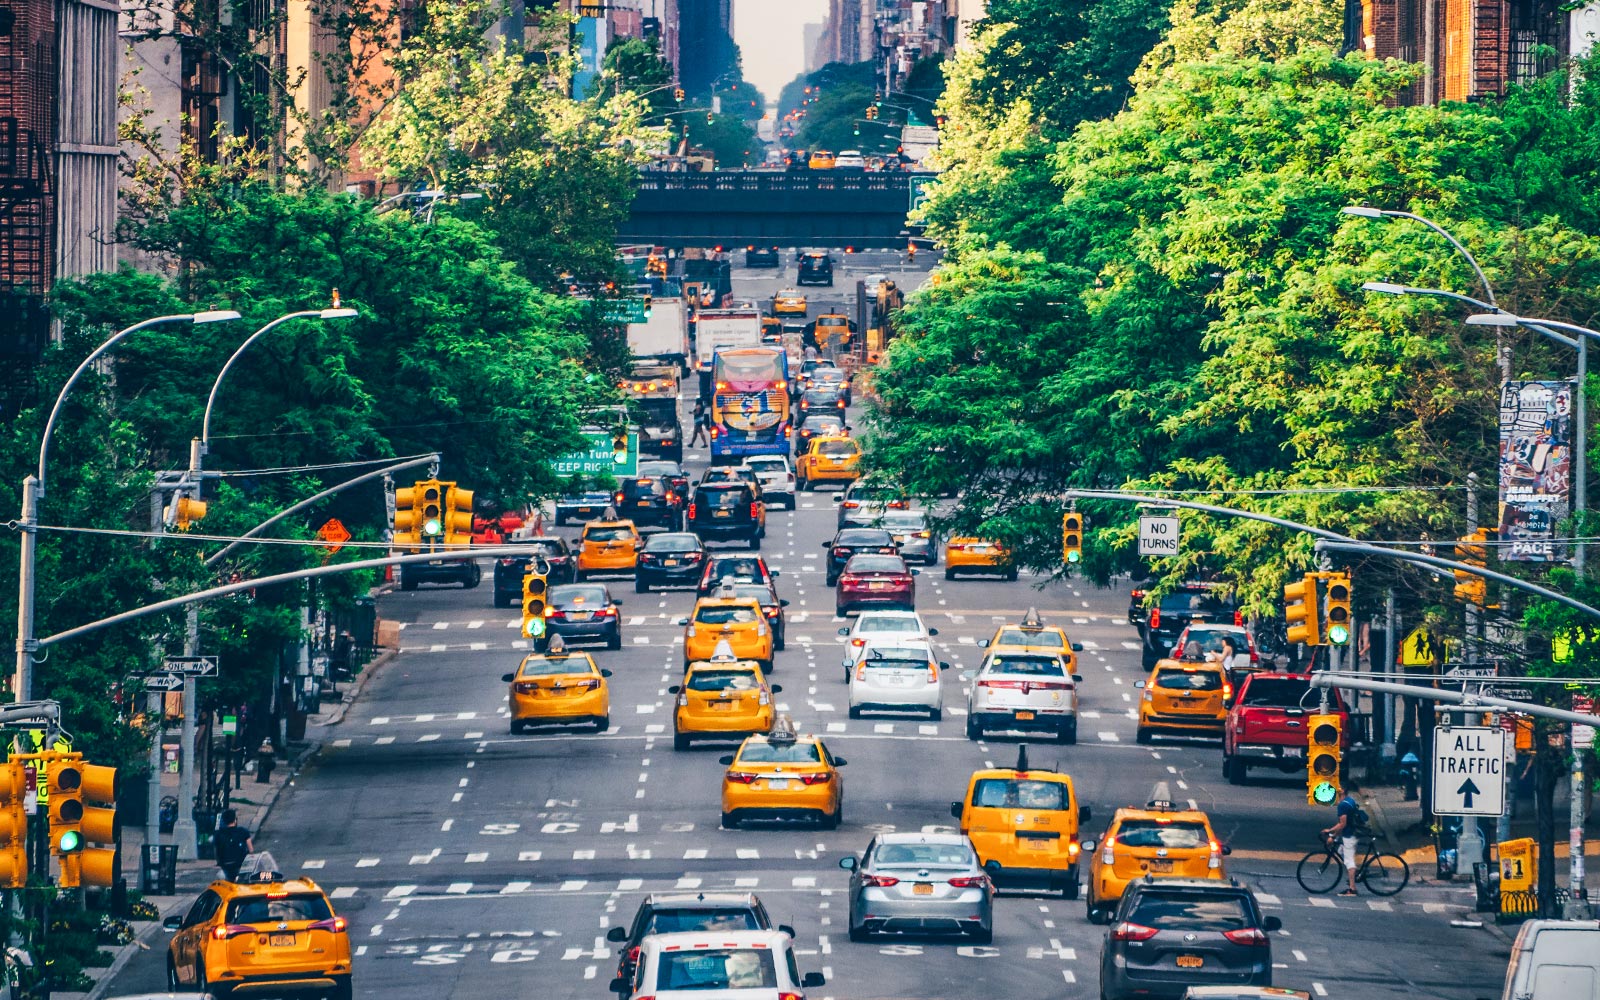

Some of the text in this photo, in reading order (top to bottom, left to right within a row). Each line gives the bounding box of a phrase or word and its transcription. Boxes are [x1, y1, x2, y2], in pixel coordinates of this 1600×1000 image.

[1506, 486, 1533, 494] JEAN
[1506, 494, 1560, 502] DUBUFFET
[1151, 523, 1167, 534] NO
[1142, 538, 1176, 550] TURNS
[1512, 541, 1553, 554] PACE
[168, 662, 209, 671] ONE WAY
[1453, 669, 1494, 677] ONE WAY
[157, 678, 176, 686] WAY
[1454, 735, 1486, 752] ALL
[1439, 756, 1500, 775] TRAFFIC
